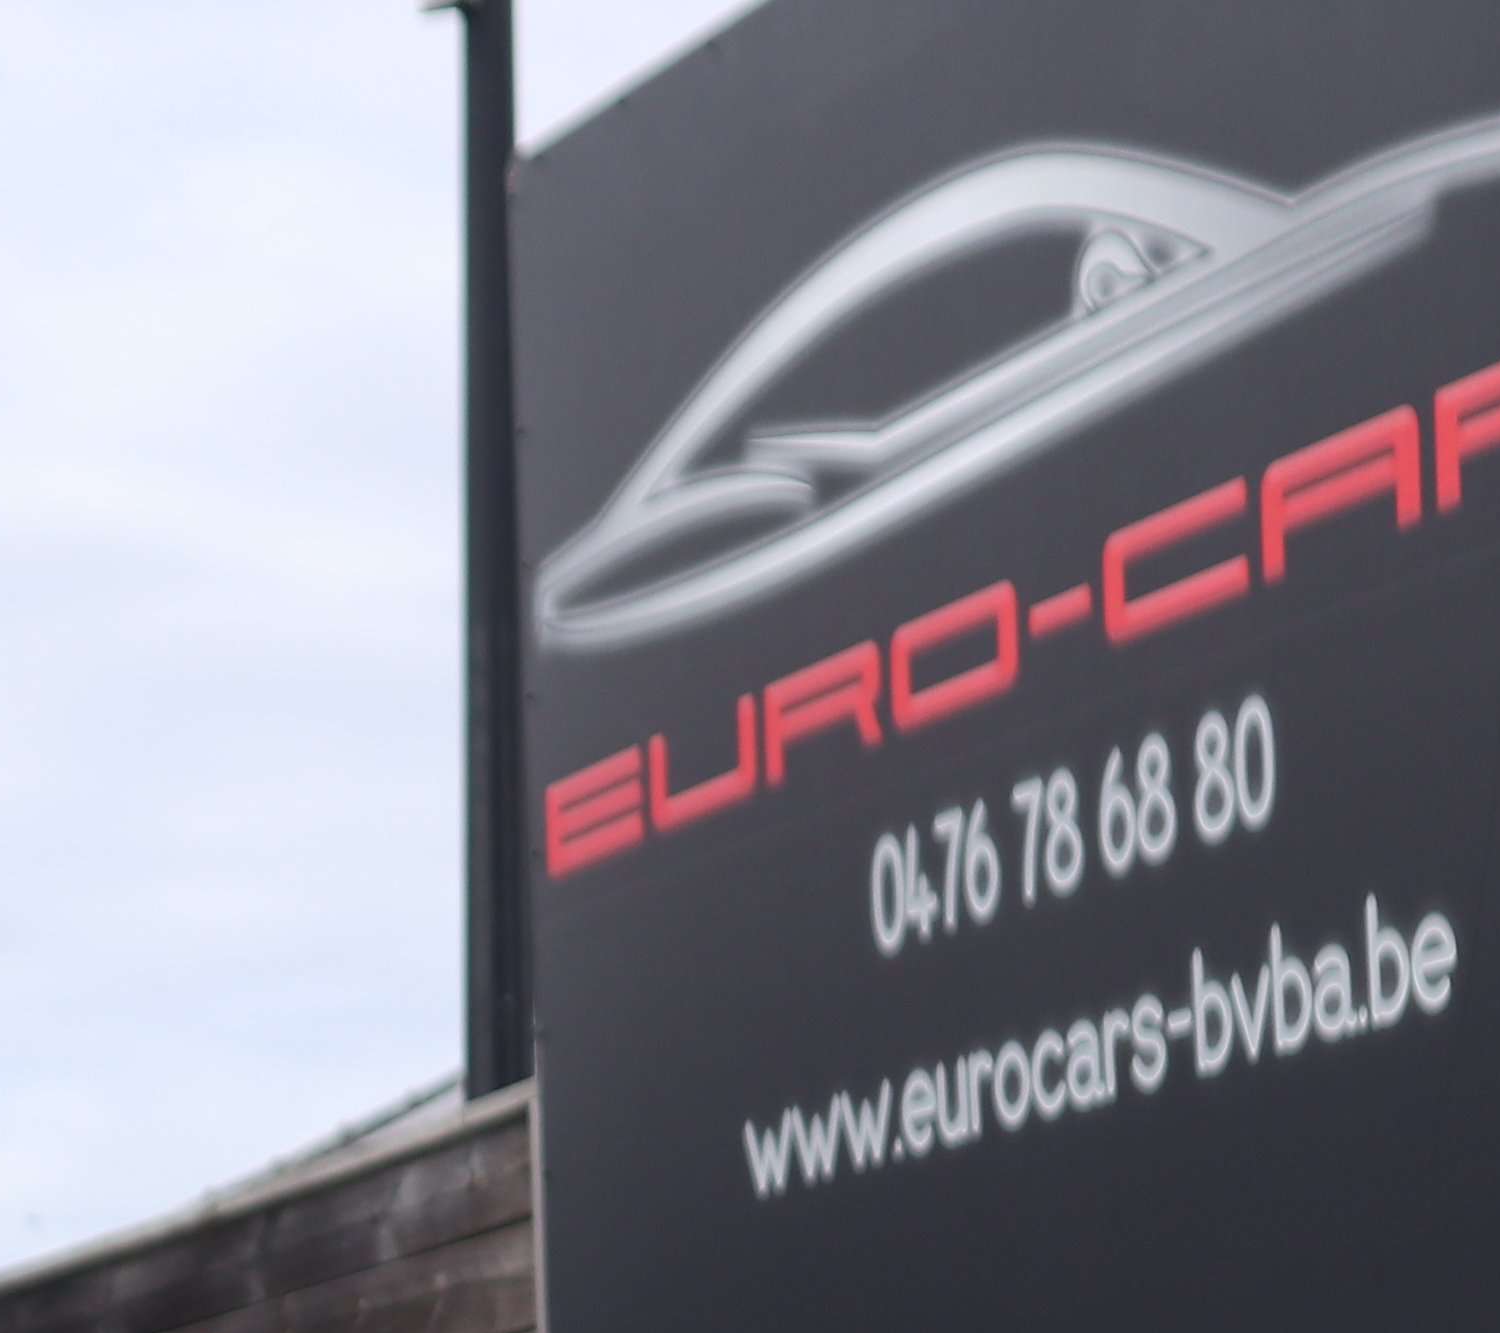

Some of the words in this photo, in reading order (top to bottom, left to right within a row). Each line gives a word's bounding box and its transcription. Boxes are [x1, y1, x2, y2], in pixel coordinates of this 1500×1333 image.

[871, 798, 1001, 954] 0476
[1011, 767, 1084, 903] 78
[1099, 733, 1177, 875] 68
[1194, 694, 1275, 844] 80
[745, 894, 1458, 1196] www.eurocars-bvba.be
